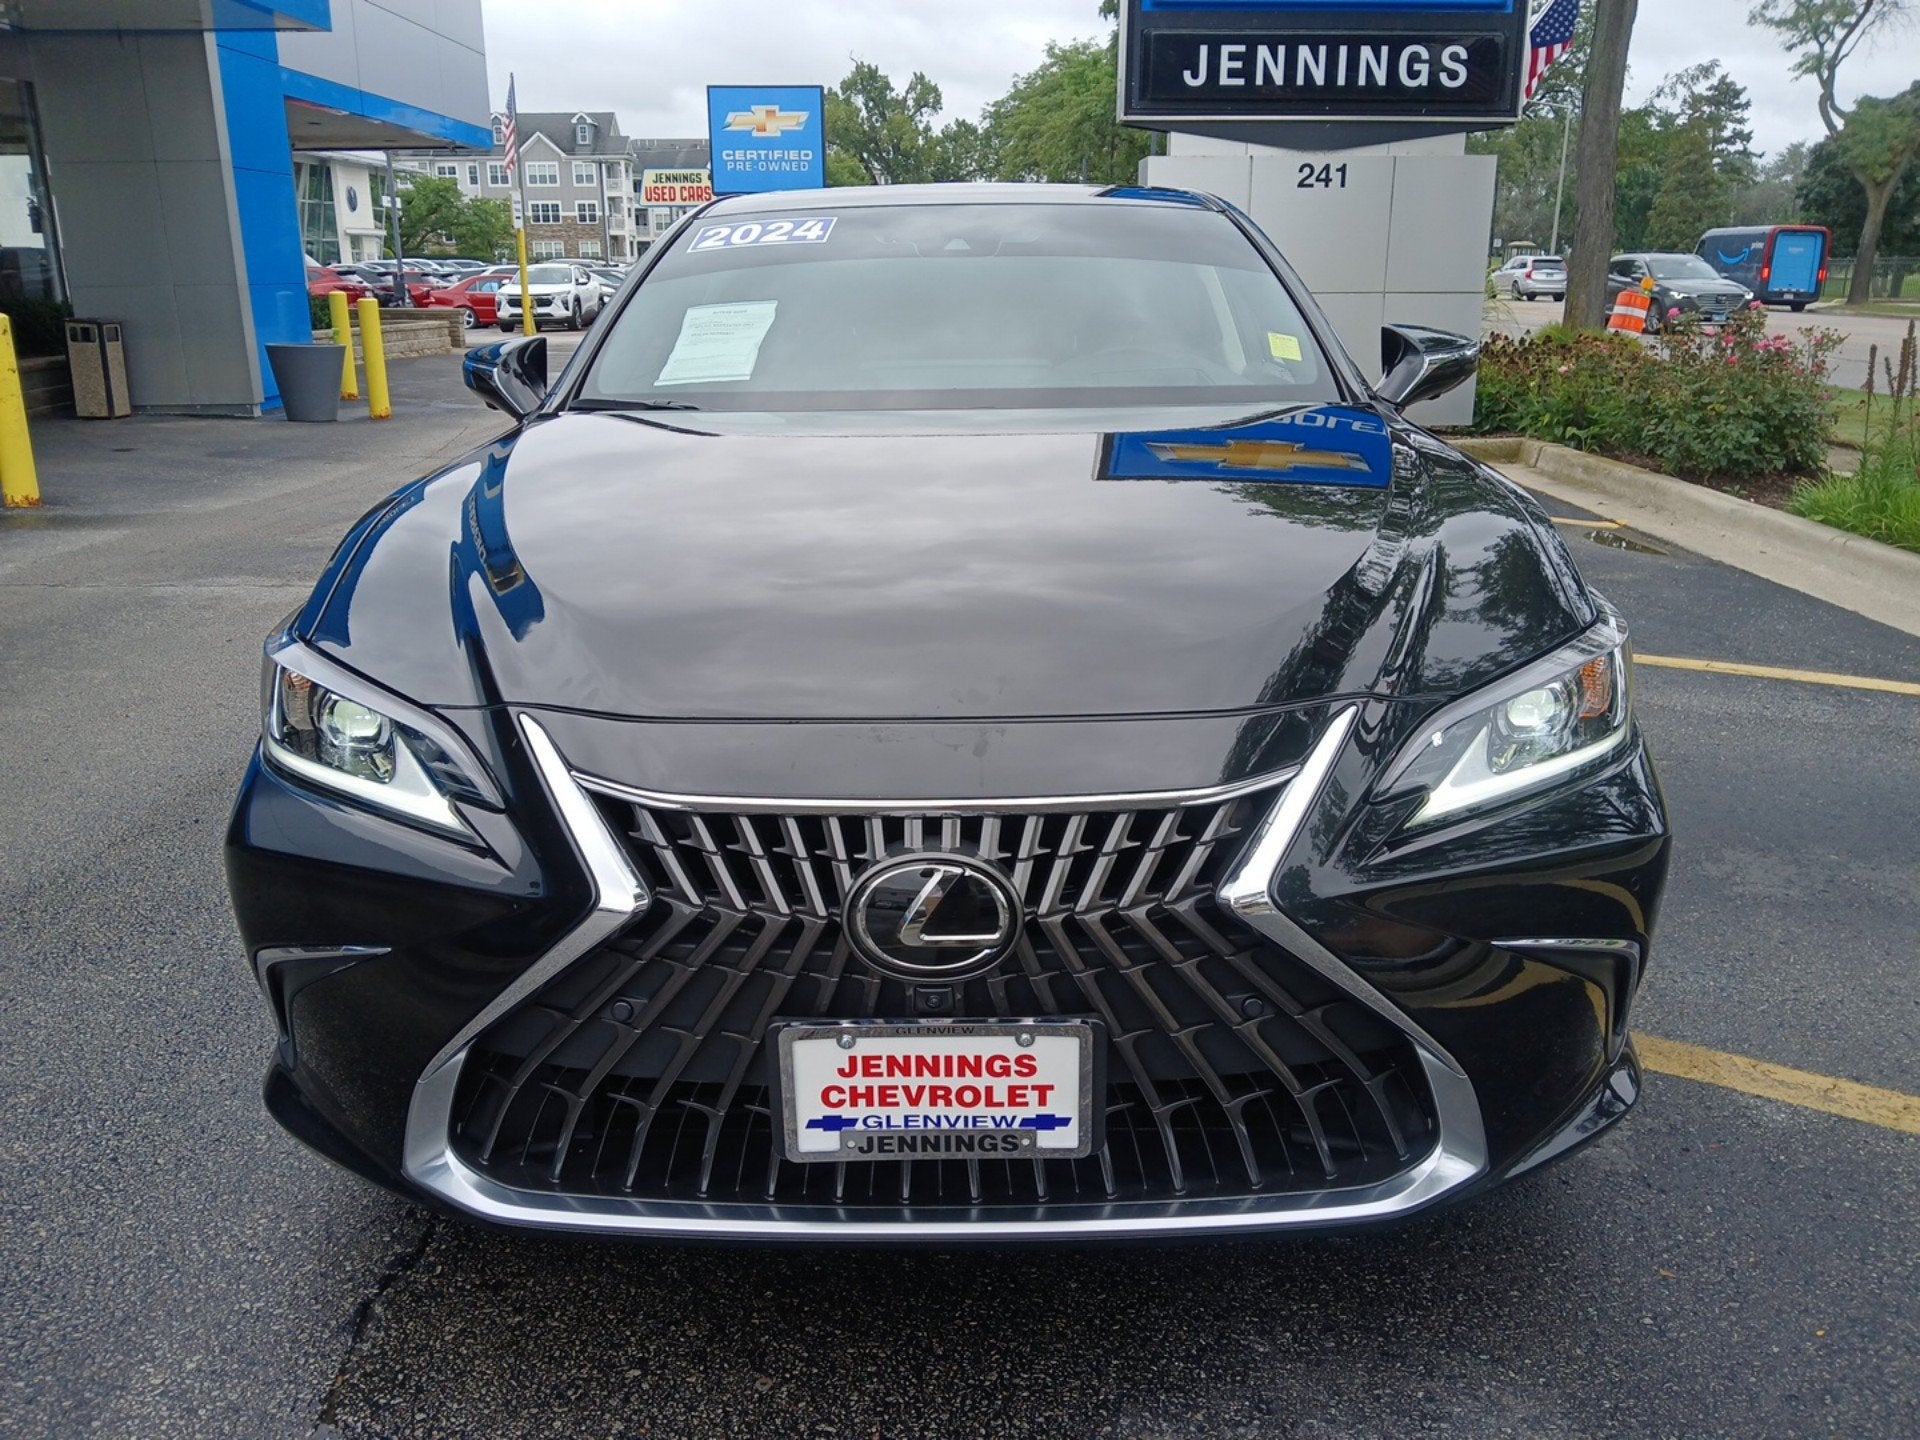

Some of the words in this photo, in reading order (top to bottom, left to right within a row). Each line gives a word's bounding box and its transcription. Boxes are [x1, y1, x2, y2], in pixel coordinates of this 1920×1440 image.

[1183, 44, 1468, 88] JENNINGS
[721, 149, 813, 160] CERTIFIED
[727, 161, 809, 171] PRE-OWNED
[652, 172, 702, 184] JENNINGS
[1297, 163, 1348, 188] 241
[644, 186, 676, 202] USED
[680, 186, 712, 202] CARS
[695, 219, 824, 248] 2024
[895, 1026, 975, 1034] GLENVIEW
[837, 1054, 1038, 1078] JENNINGS
[820, 1084, 1055, 1108] CHEVROLET
[861, 1114, 1020, 1130] GLENVIEW
[857, 1133, 1020, 1154] JENNINGS
